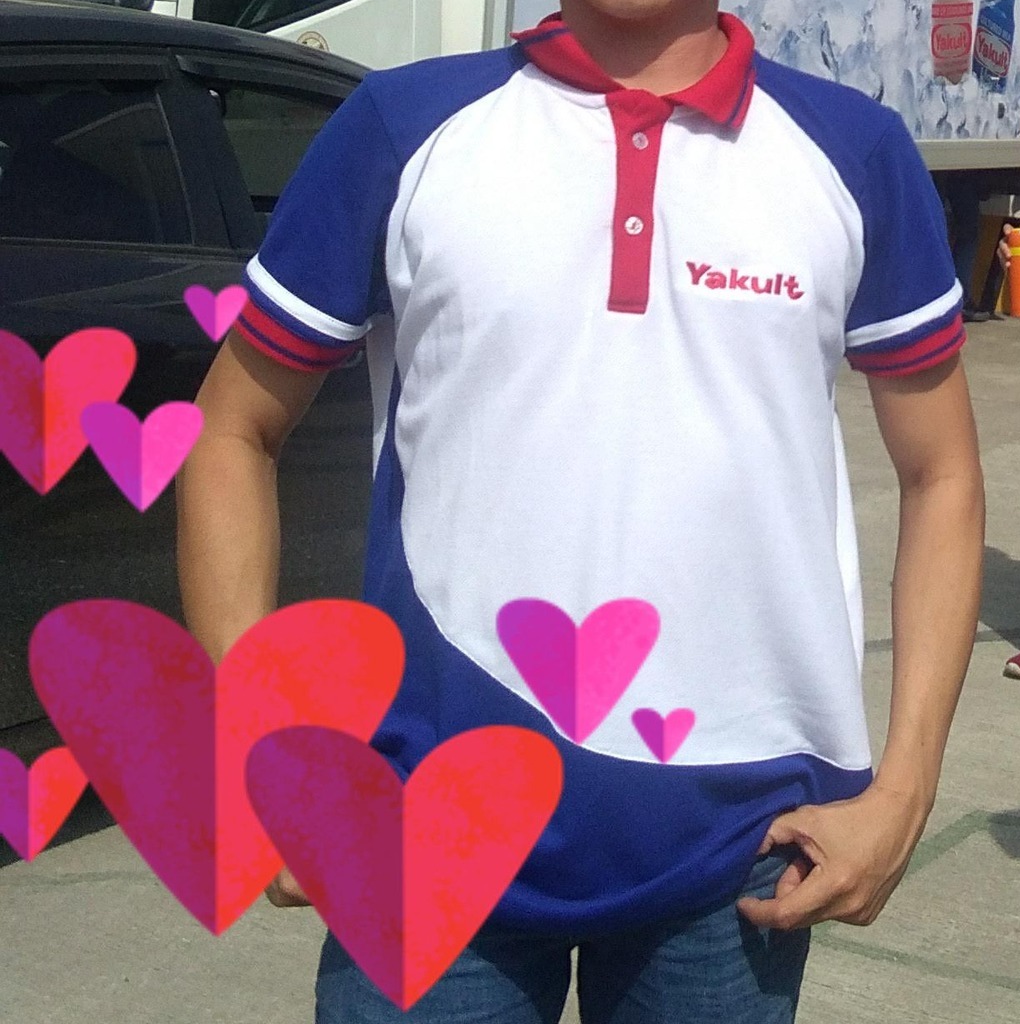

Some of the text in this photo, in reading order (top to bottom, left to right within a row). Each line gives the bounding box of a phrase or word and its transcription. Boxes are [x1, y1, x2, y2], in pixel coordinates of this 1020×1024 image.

[935, 31, 967, 51] Yakult
[978, 34, 1008, 71] Yakult
[686, 260, 805, 300] Yakult
